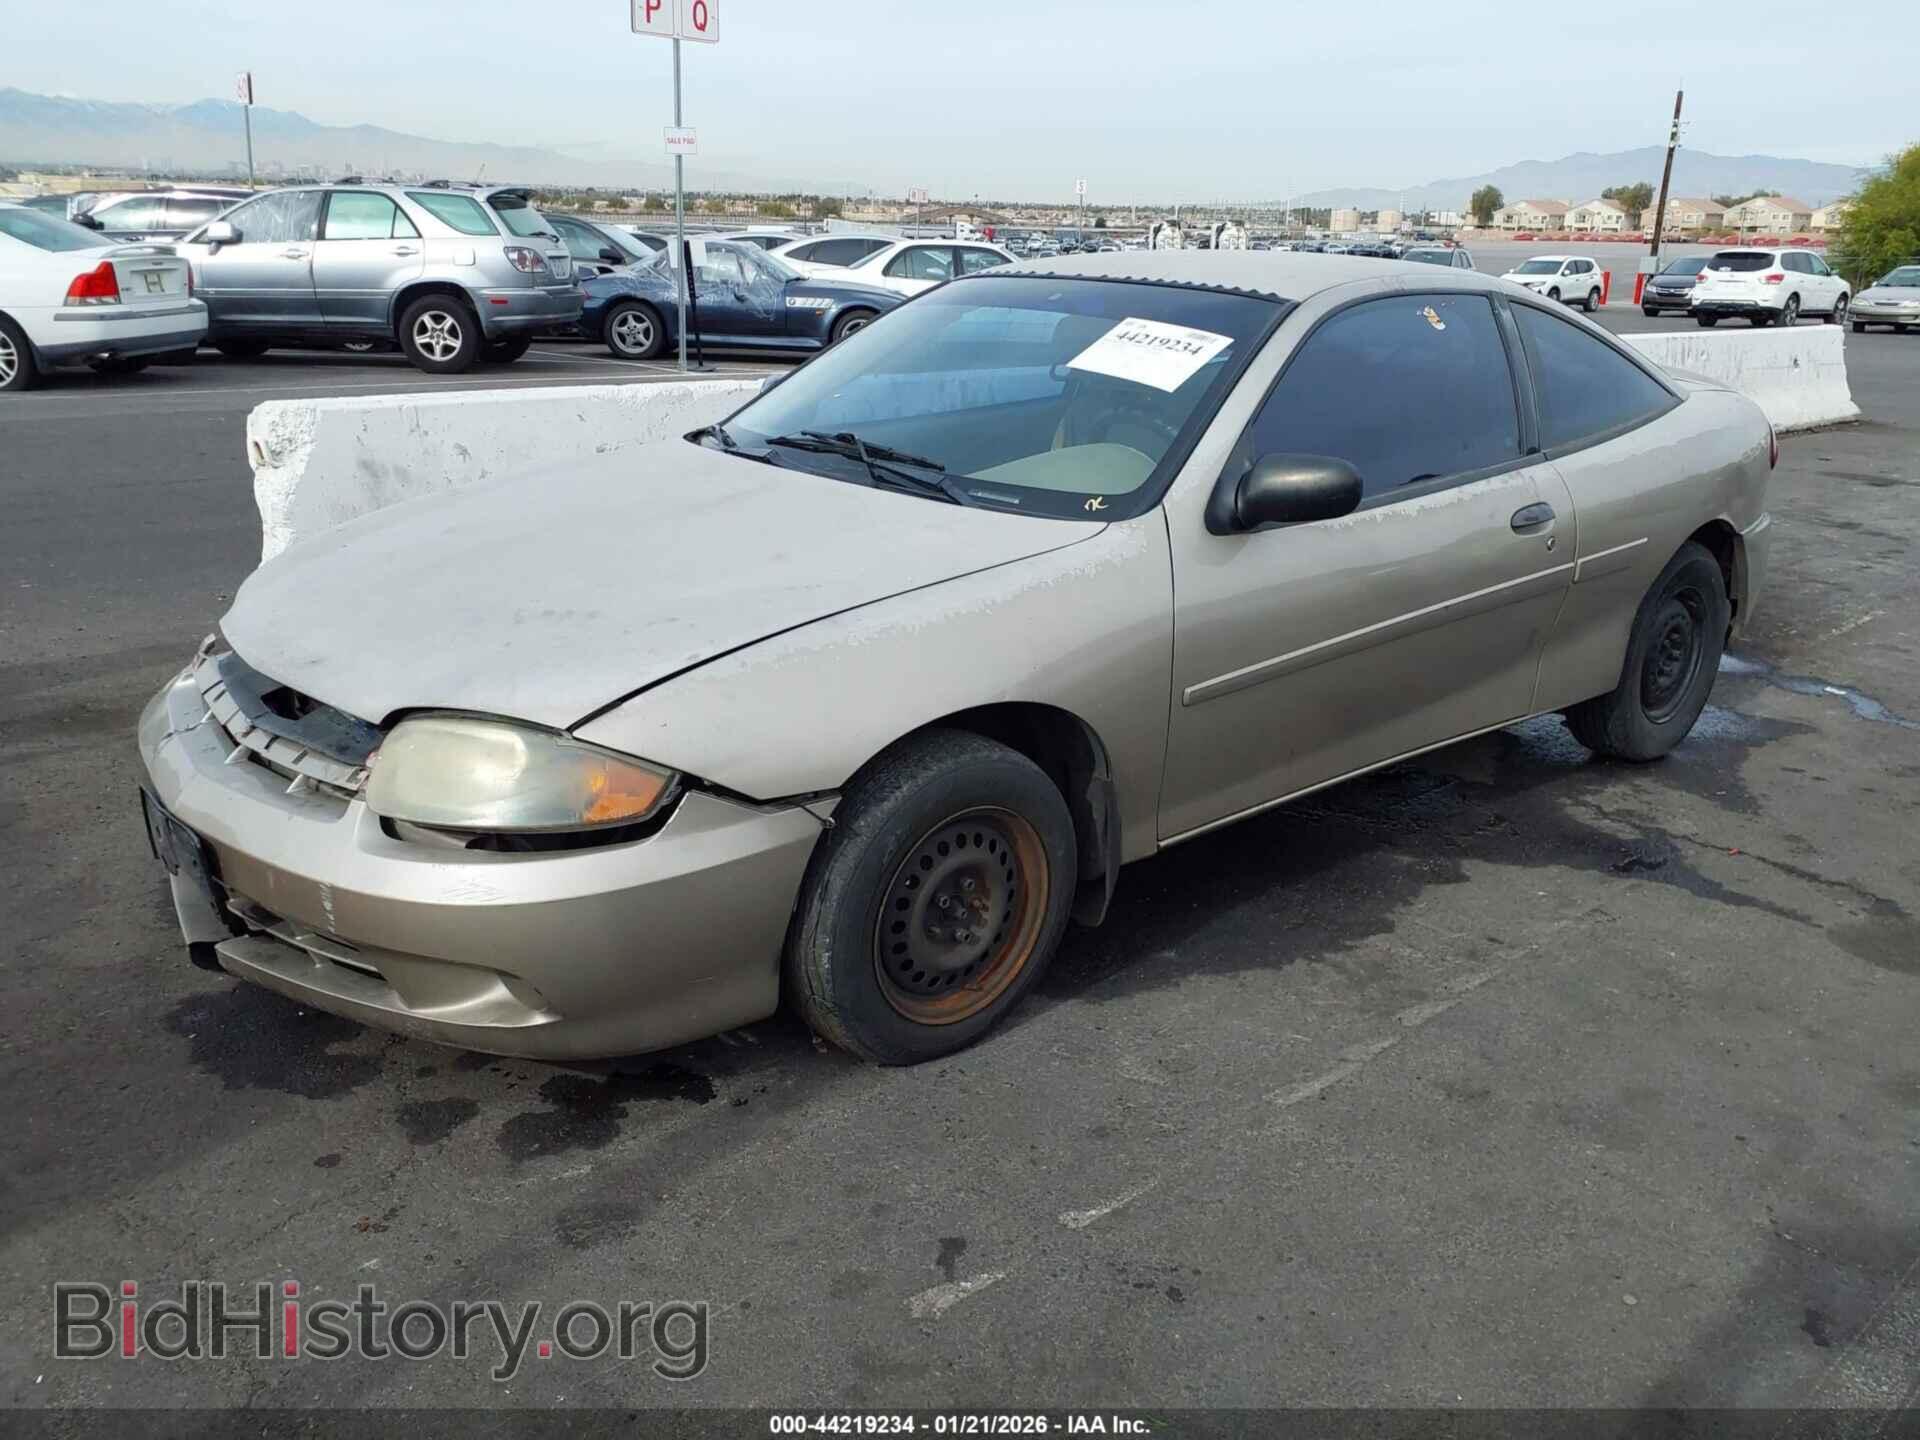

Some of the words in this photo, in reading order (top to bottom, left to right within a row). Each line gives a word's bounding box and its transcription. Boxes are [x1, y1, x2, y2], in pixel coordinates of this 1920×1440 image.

[645, 0, 661, 23] P
[693, 0, 707, 32] Q
[1116, 330, 1205, 356] 44219234
